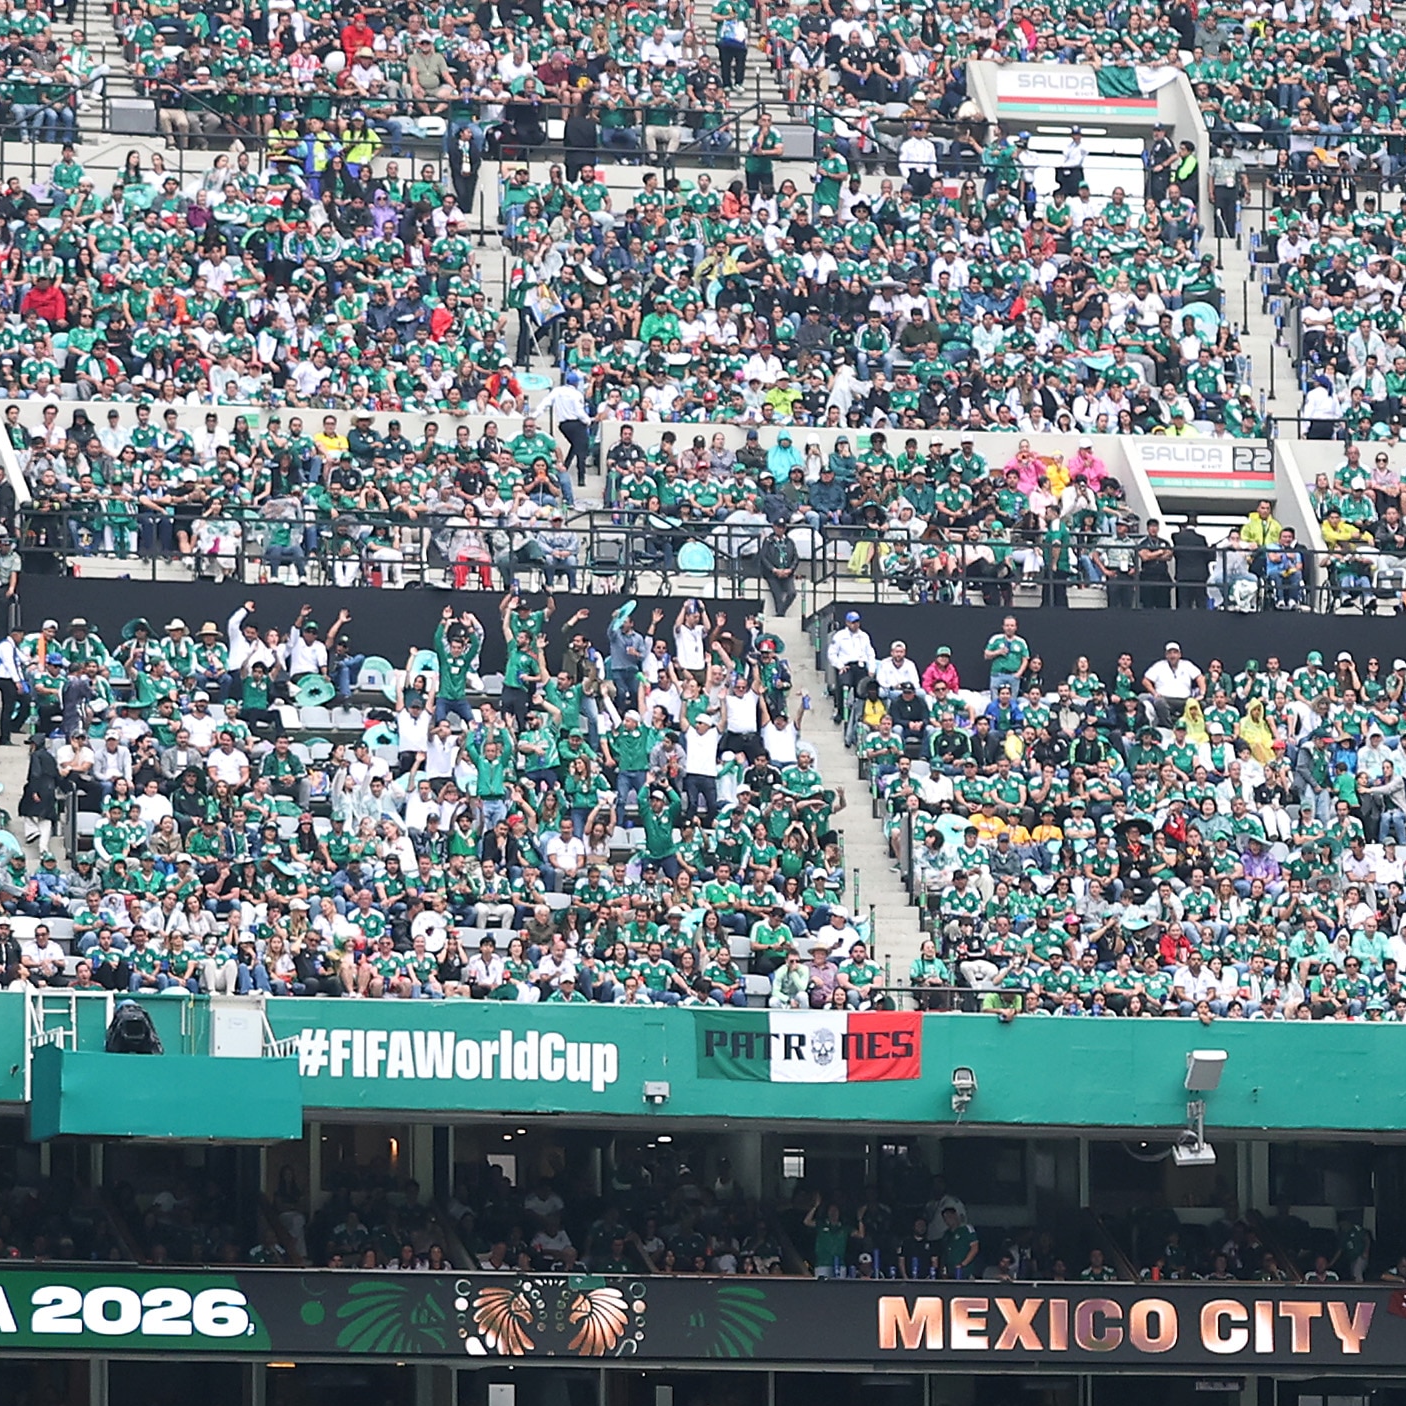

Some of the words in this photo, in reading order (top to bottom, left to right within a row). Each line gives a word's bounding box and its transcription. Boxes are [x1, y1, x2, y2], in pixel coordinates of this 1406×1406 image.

[1018, 74, 1095, 90] SALIDA
[1141, 446, 1223, 463] SALIDA
[1234, 448, 1273, 472] 22
[298, 1029, 618, 1092] #FIFAWorldCup
[31, 1285, 249, 1337] 2026
[877, 1295, 1178, 1353] MEXICO
[1200, 1299, 1376, 1354] CITY
